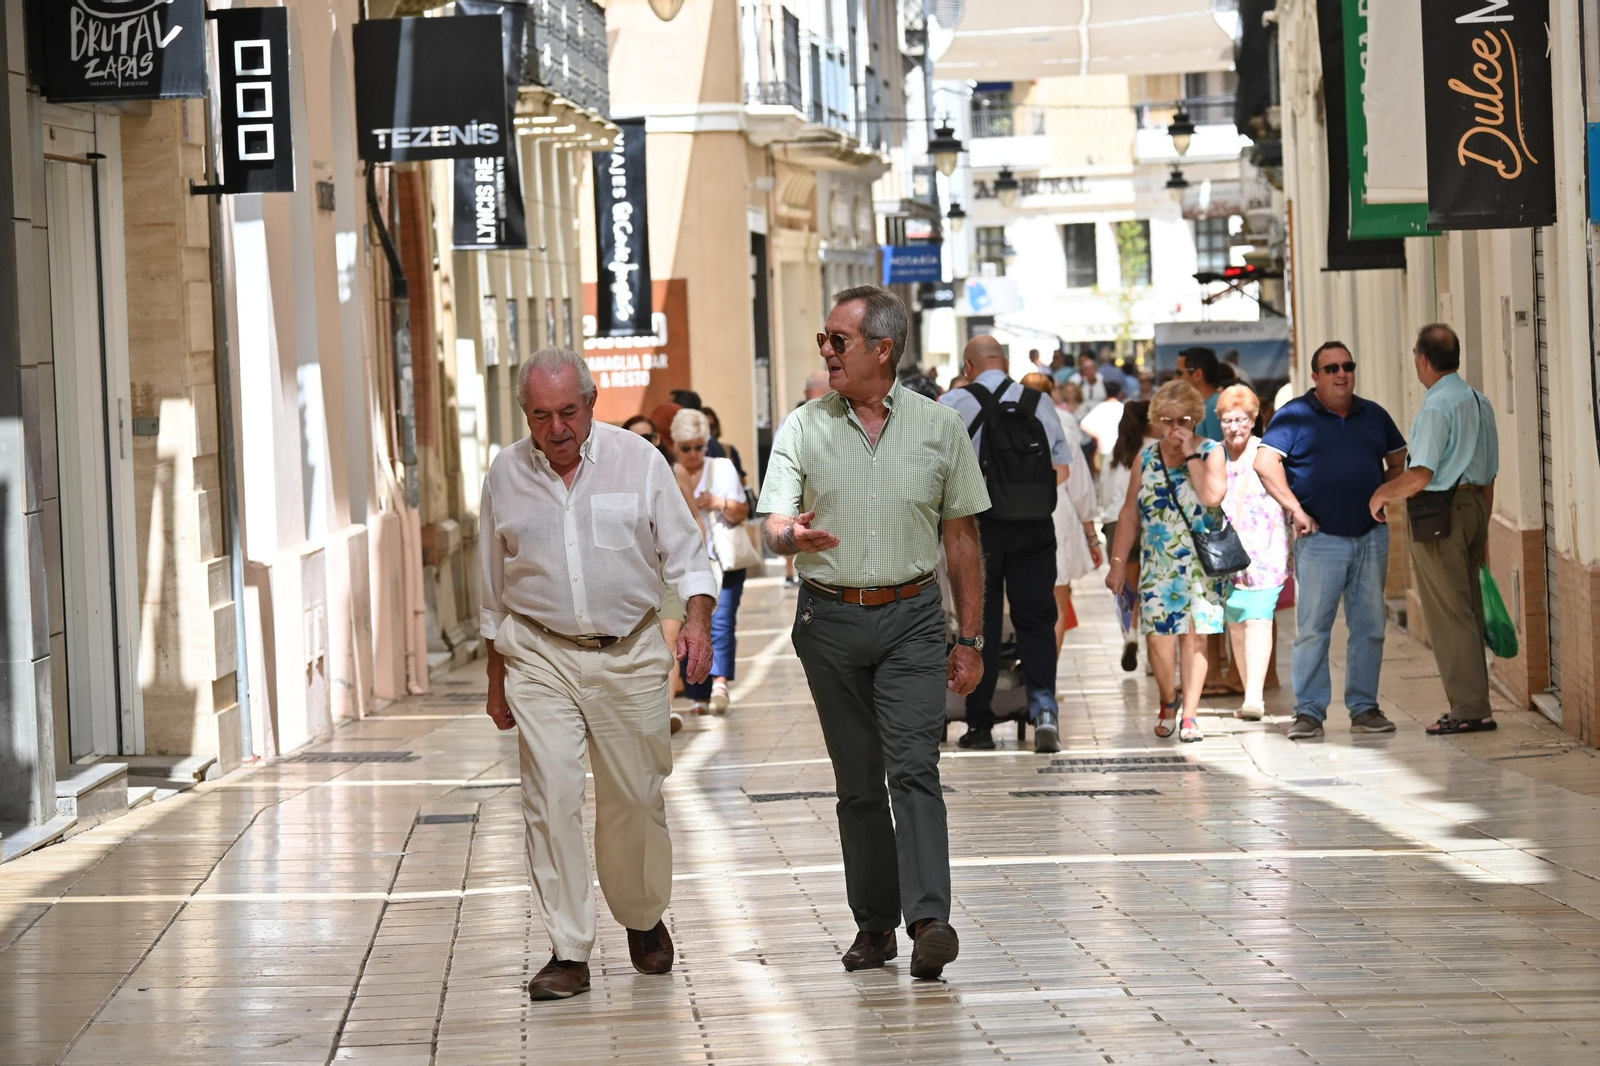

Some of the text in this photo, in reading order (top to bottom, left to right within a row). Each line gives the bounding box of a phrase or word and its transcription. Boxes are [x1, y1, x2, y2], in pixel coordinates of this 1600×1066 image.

[70, 6, 183, 61] BRUTAL
[84, 52, 154, 88] ZAPAS
[1448, 30, 1522, 179] Dulce
[608, 132, 627, 199] VIAJES
[475, 184, 497, 244] LYNCIS
[584, 355, 641, 372] ANAGLIA
